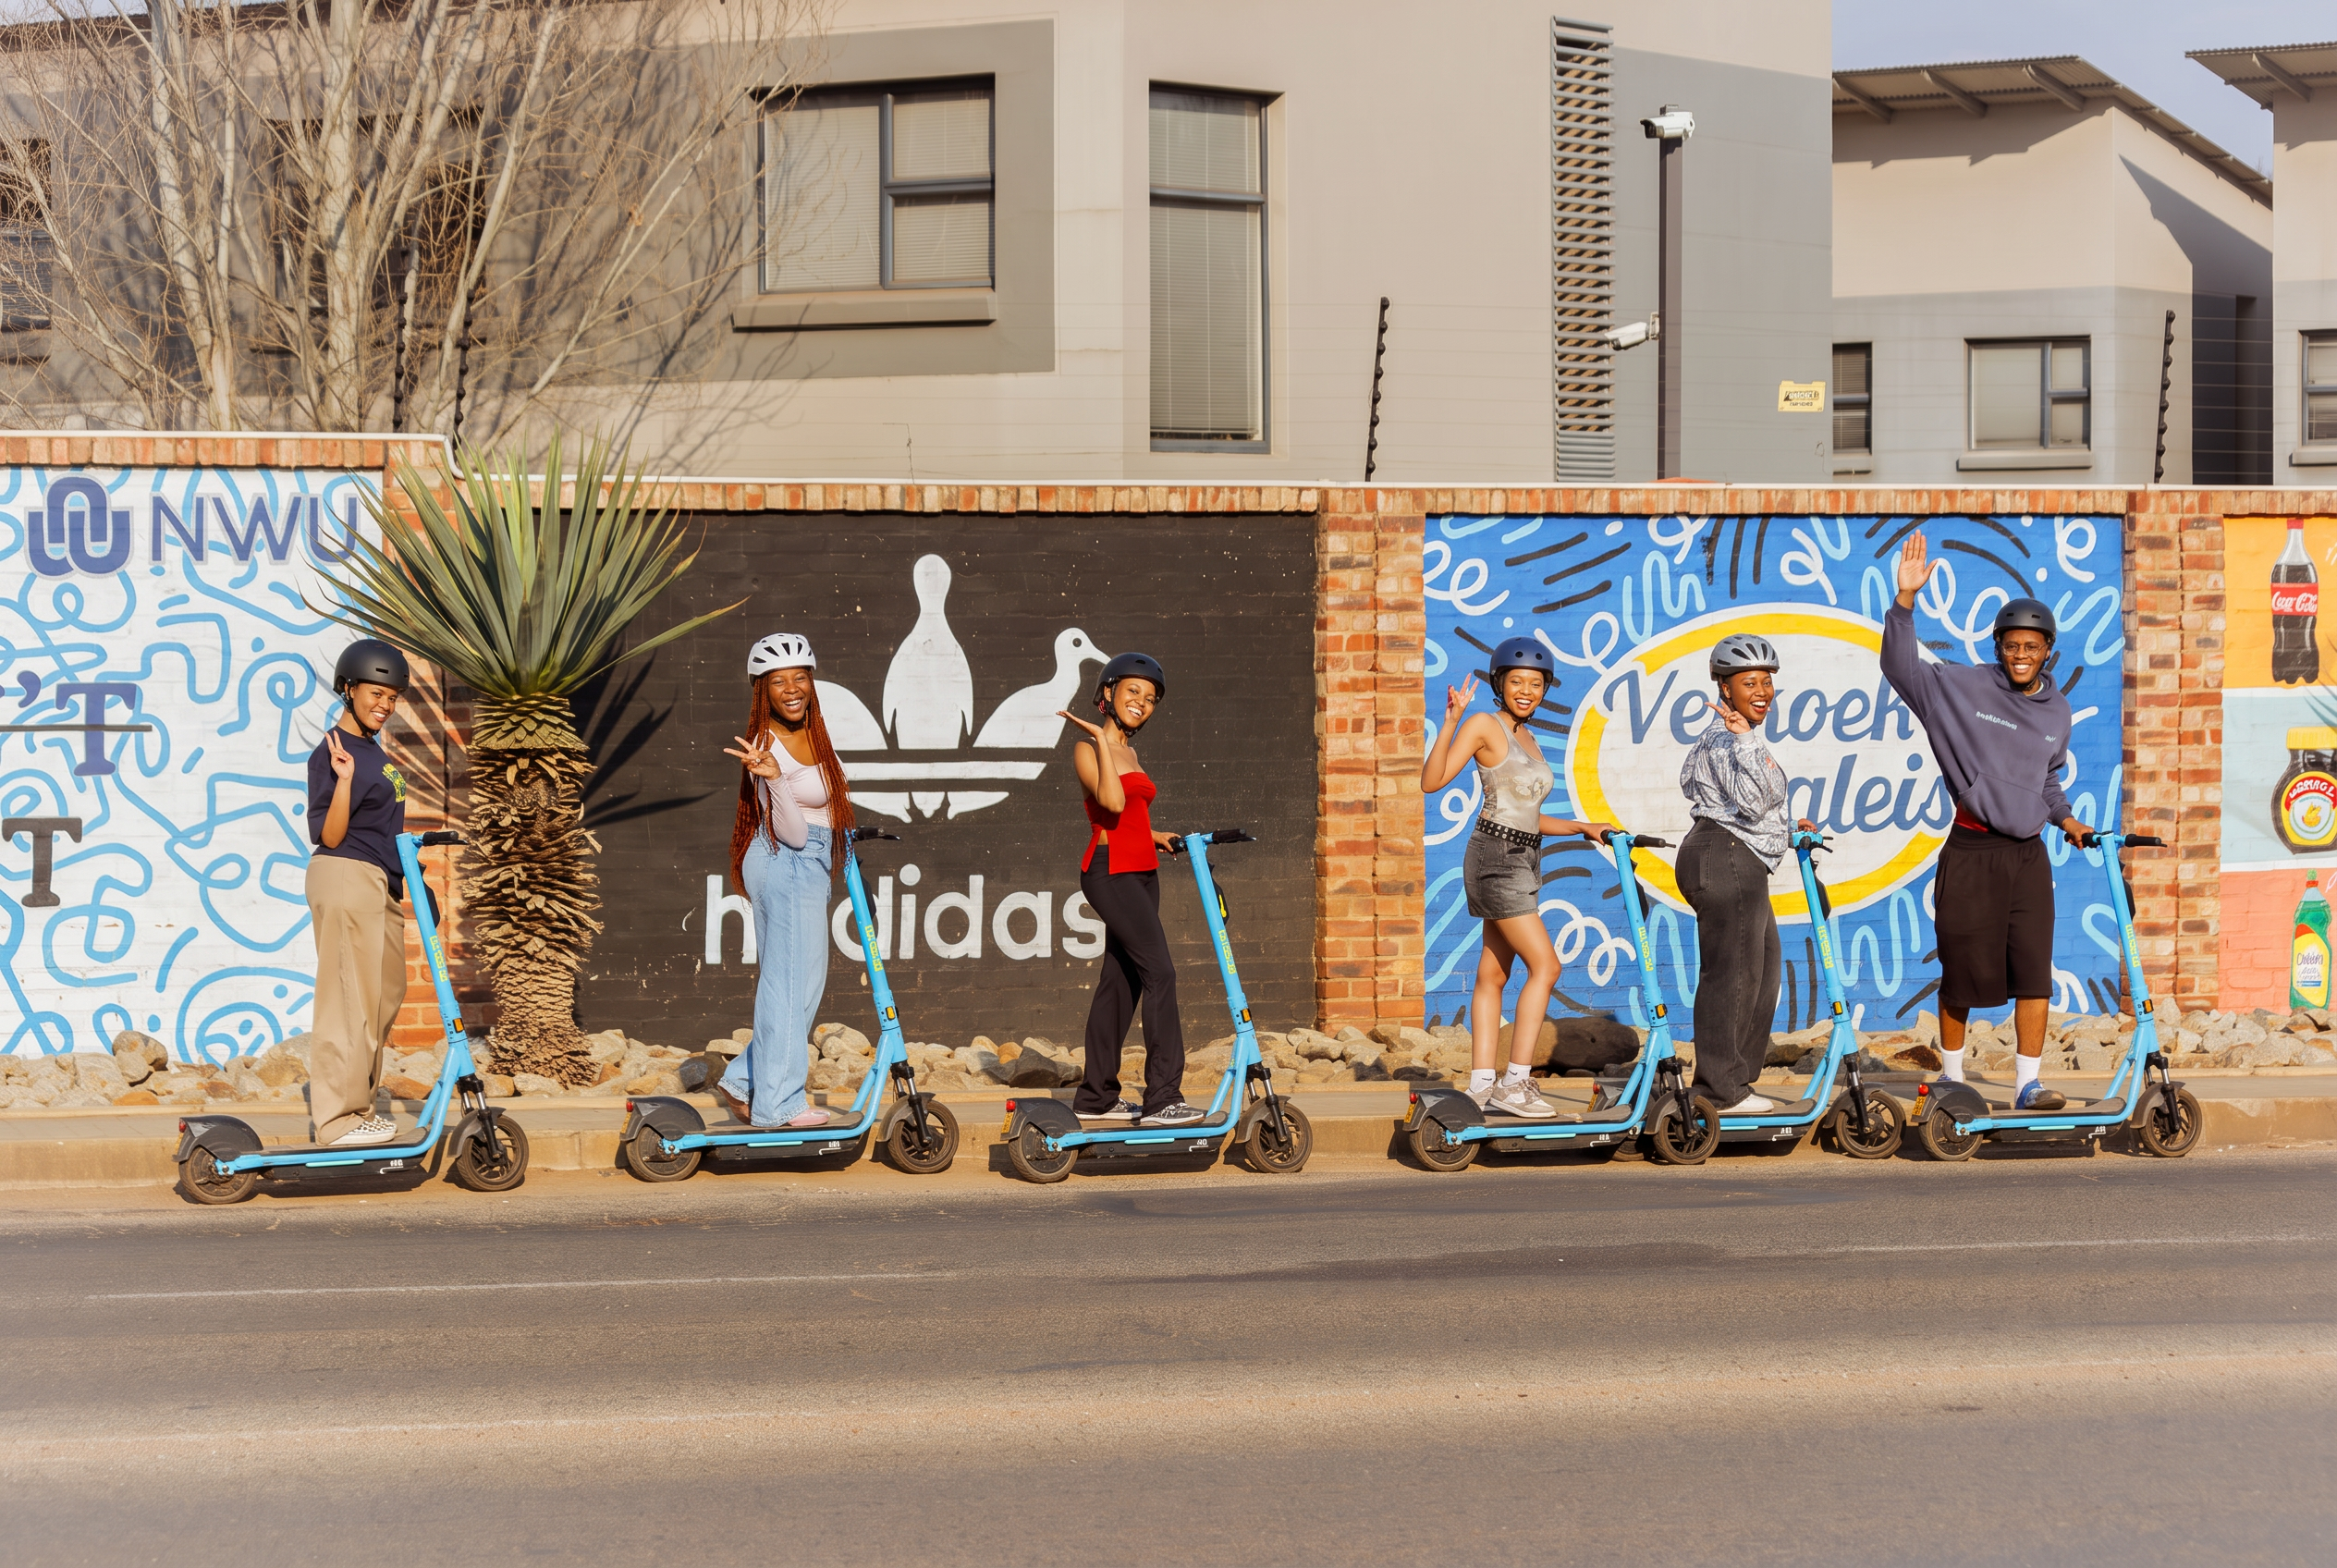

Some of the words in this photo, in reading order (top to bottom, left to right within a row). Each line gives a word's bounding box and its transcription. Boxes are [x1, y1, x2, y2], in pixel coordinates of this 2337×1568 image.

[150, 495, 359, 563] NWU
[1602, 669, 1915, 744] Veoek
[1787, 752, 1953, 834] aleis
[705, 864, 1106, 964] hdidas
